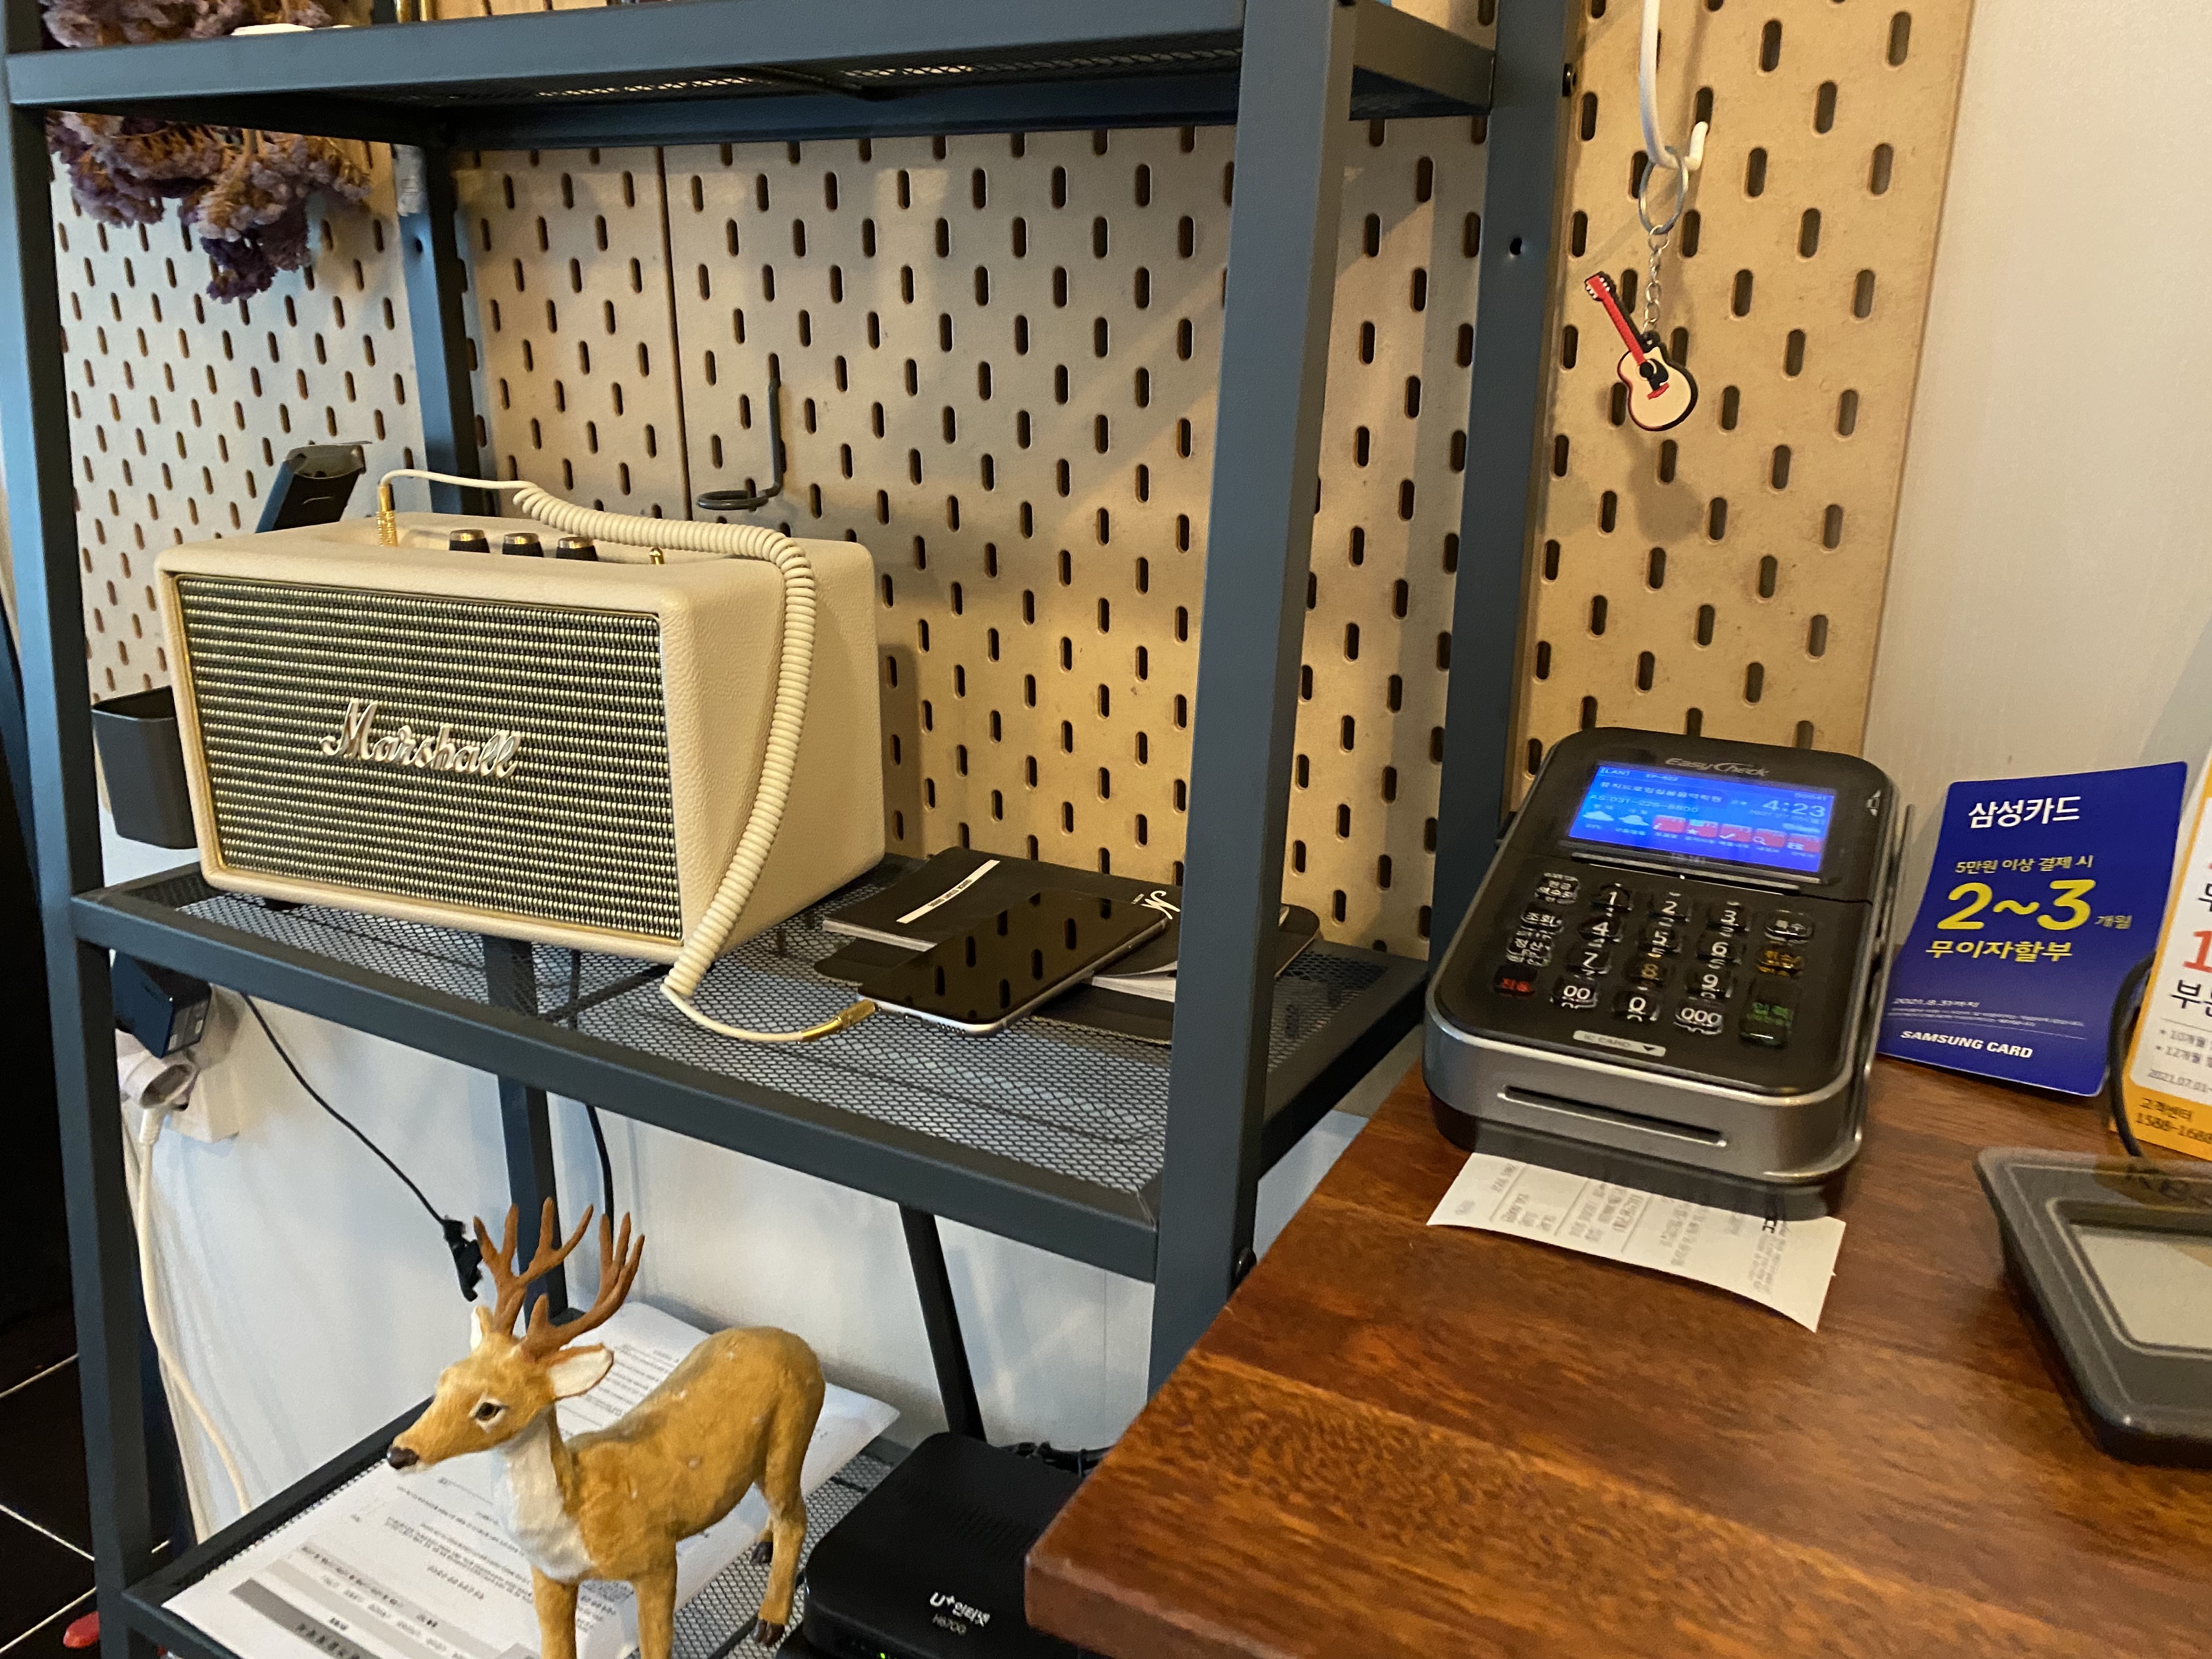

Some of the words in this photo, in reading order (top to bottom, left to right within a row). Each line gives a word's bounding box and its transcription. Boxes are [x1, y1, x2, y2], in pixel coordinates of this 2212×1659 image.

[319, 697, 521, 778] Marshall
[1762, 799, 1826, 817] 4:23
[1968, 796, 2081, 829] 삼성카드
[1954, 859, 1998, 874] 5만원
[2002, 858, 2035, 872] 이상
[2038, 856, 2073, 871] 결제
[2075, 855, 2094, 868] 시
[1609, 891, 1618, 905] 1
[1937, 879, 2096, 931] 2~3
[2094, 915, 2133, 930] 개월
[1662, 901, 1678, 915] 2
[1720, 910, 1737, 924] 3
[1592, 922, 1609, 936] 4
[1652, 930, 1668, 946] 5
[1712, 941, 1729, 956] 6
[1926, 940, 2073, 963] 무이자할부
[1701, 974, 1719, 988] 9
[1563, 985, 1591, 1000] 00
[1628, 996, 1646, 1012] 0
[1680, 1007, 1722, 1024] 000
[1900, 1030, 1984, 1050] SAMSUNG
[1986, 1041, 2034, 1059] CARD
